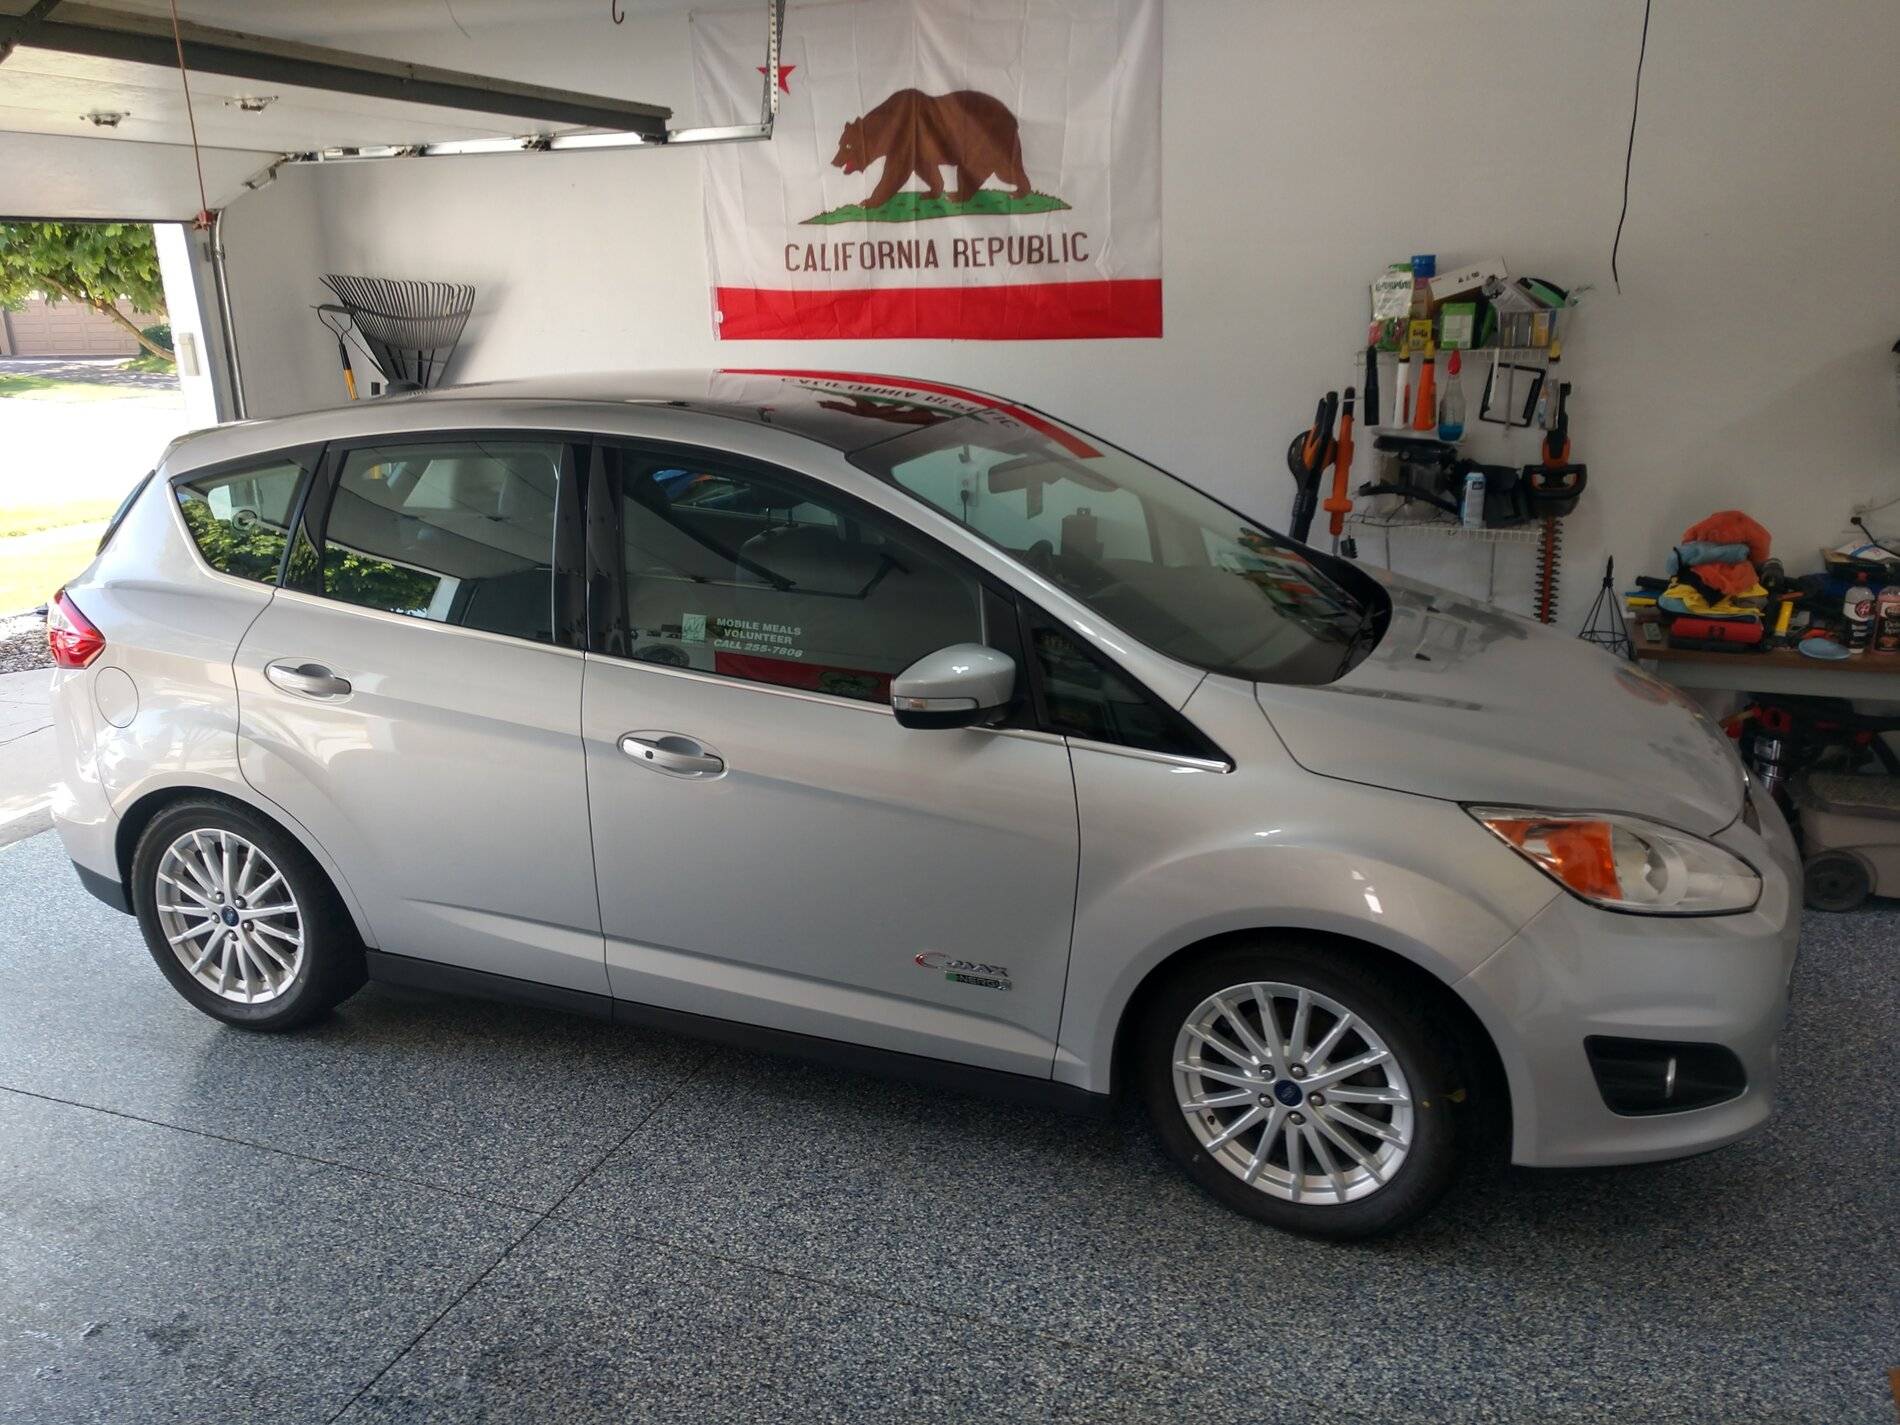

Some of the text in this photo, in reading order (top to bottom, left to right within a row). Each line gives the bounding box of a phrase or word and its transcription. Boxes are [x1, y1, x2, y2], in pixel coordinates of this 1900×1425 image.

[784, 232, 1089, 272] CALIFORNIA REPUBLIC
[716, 617, 760, 630] MOBILE
[762, 623, 802, 636] MEALS
[713, 638, 741, 650] CALL
[723, 628, 793, 645] VOLUNTEER
